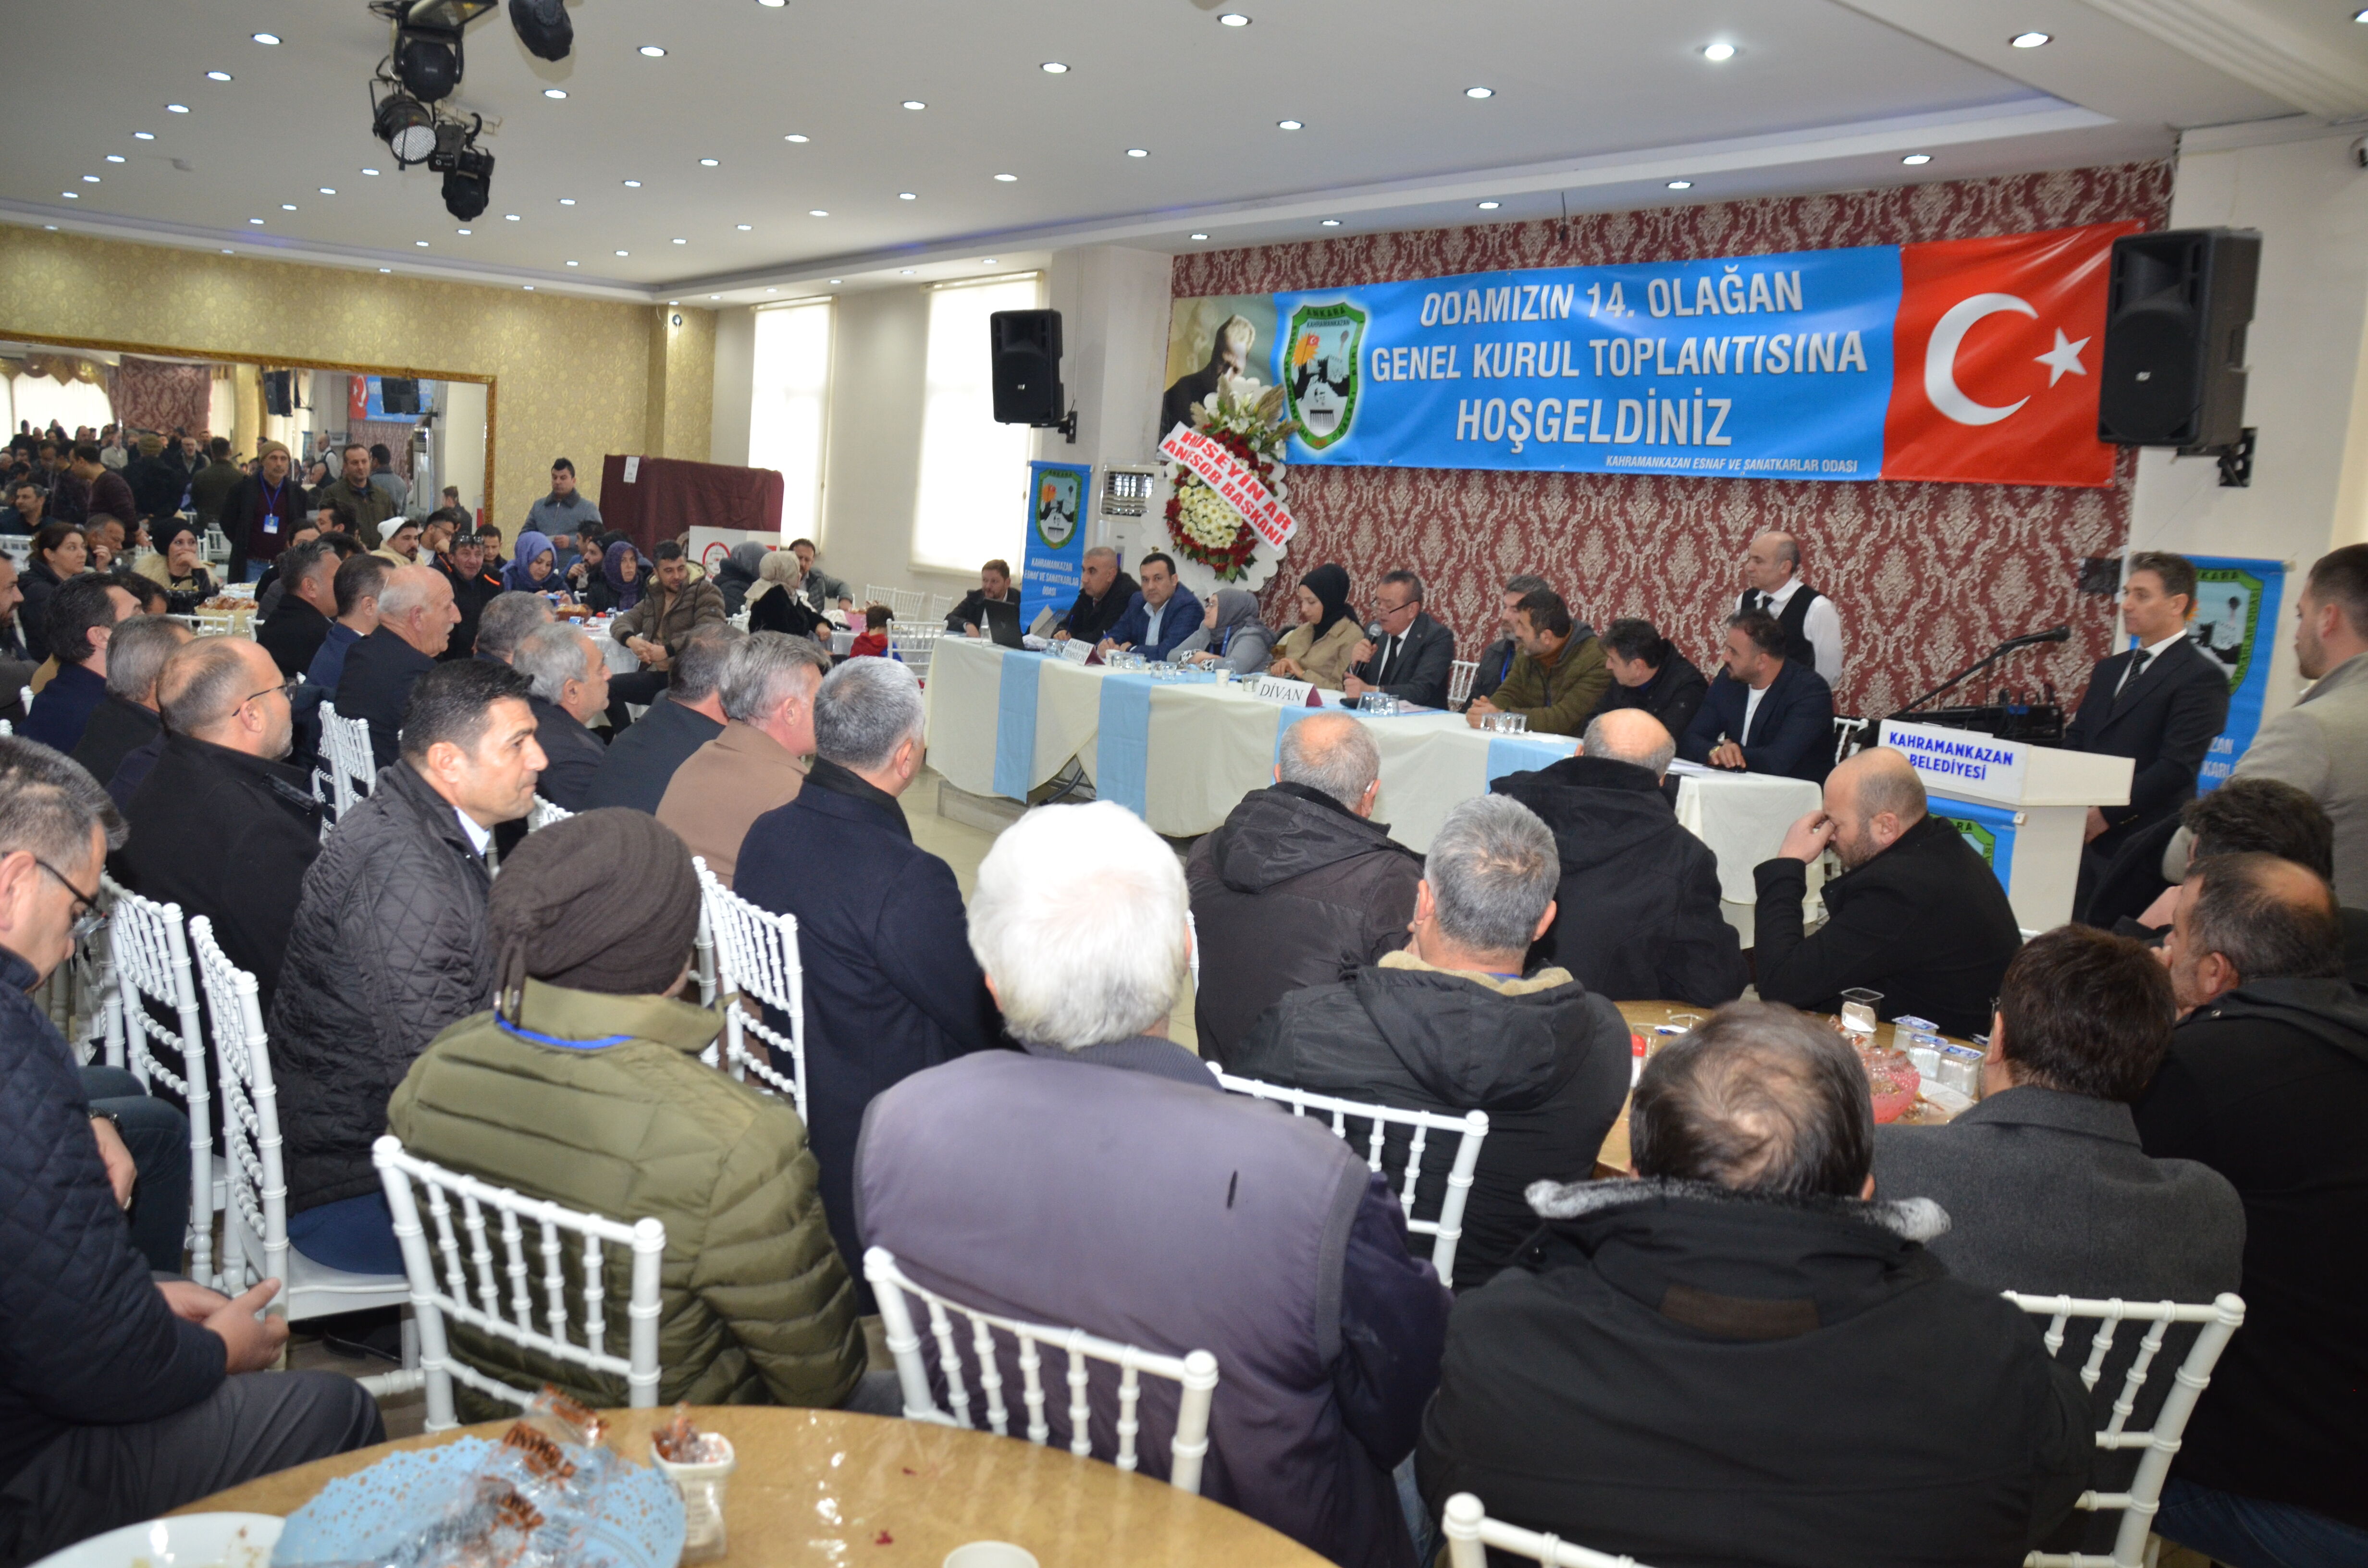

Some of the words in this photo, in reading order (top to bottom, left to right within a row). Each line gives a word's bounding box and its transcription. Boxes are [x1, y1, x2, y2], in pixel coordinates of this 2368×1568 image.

[1420, 283, 1574, 327] ODAMIZIN
[1587, 282, 1635, 318] 14.
[1648, 264, 1803, 318] OLAĞAN
[1371, 344, 1461, 381] GENEL
[1473, 340, 1580, 378] KURUL
[1589, 331, 1868, 377] TOPLANTISINA
[1456, 387, 1732, 453] HOŞGELDİNİZ
[1606, 455, 1691, 469] KAHRAMANKAZAN
[1692, 458, 1727, 470] ESNAF
[1729, 458, 1742, 470] VE
[1743, 458, 1819, 472] SANATKARLAR
[1822, 460, 1858, 473] ODASI
[1221, 481, 1284, 546] BAŞKANI
[1263, 501, 1292, 531] AR
[1031, 557, 1073, 572] KAHRAMANKAZAN
[1259, 682, 1304, 701] DİVAN
[1889, 731, 2013, 766] KAHRAMANKAZAN
[1910, 753, 1987, 780] BELEDİYESİ
